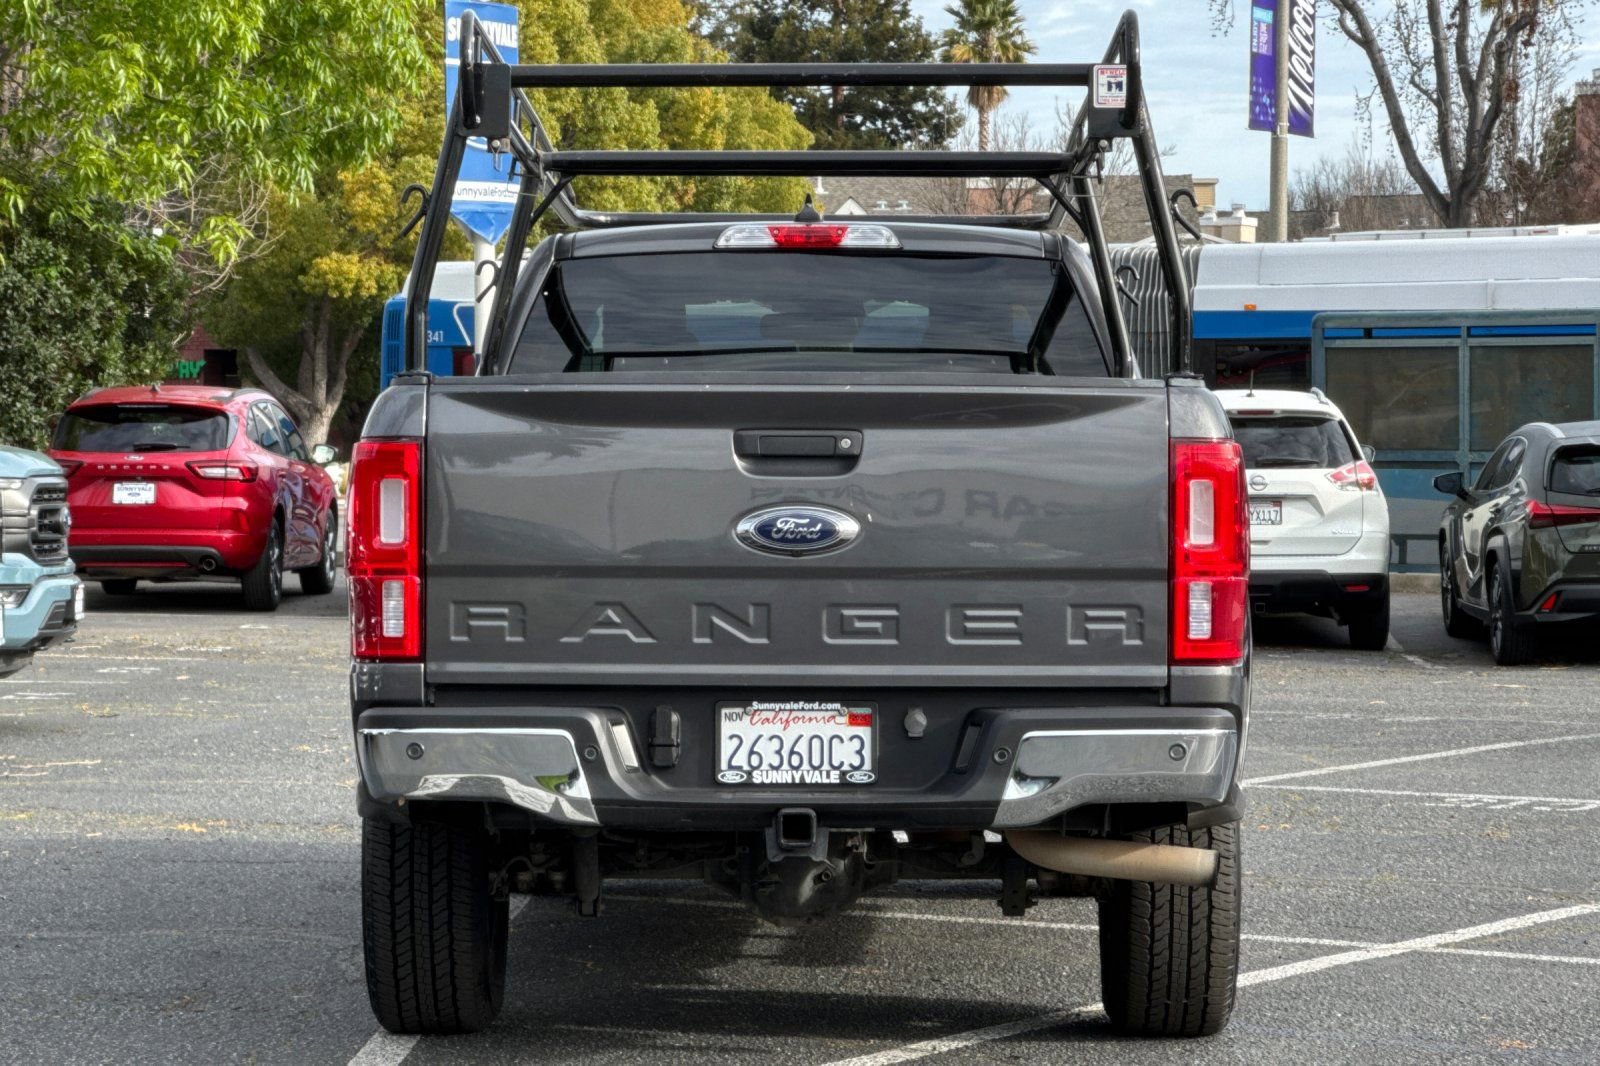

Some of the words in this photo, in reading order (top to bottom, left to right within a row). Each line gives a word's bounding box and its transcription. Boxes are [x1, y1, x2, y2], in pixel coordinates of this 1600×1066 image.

[771, 517, 822, 540] Ford
[449, 601, 1144, 647] RANGER
[724, 711, 744, 722] NOV
[752, 701, 841, 711] SunnyvaleFord.com
[750, 710, 847, 731] California
[727, 733, 865, 770] 26360C3
[752, 770, 840, 783] SUNNYVALE
